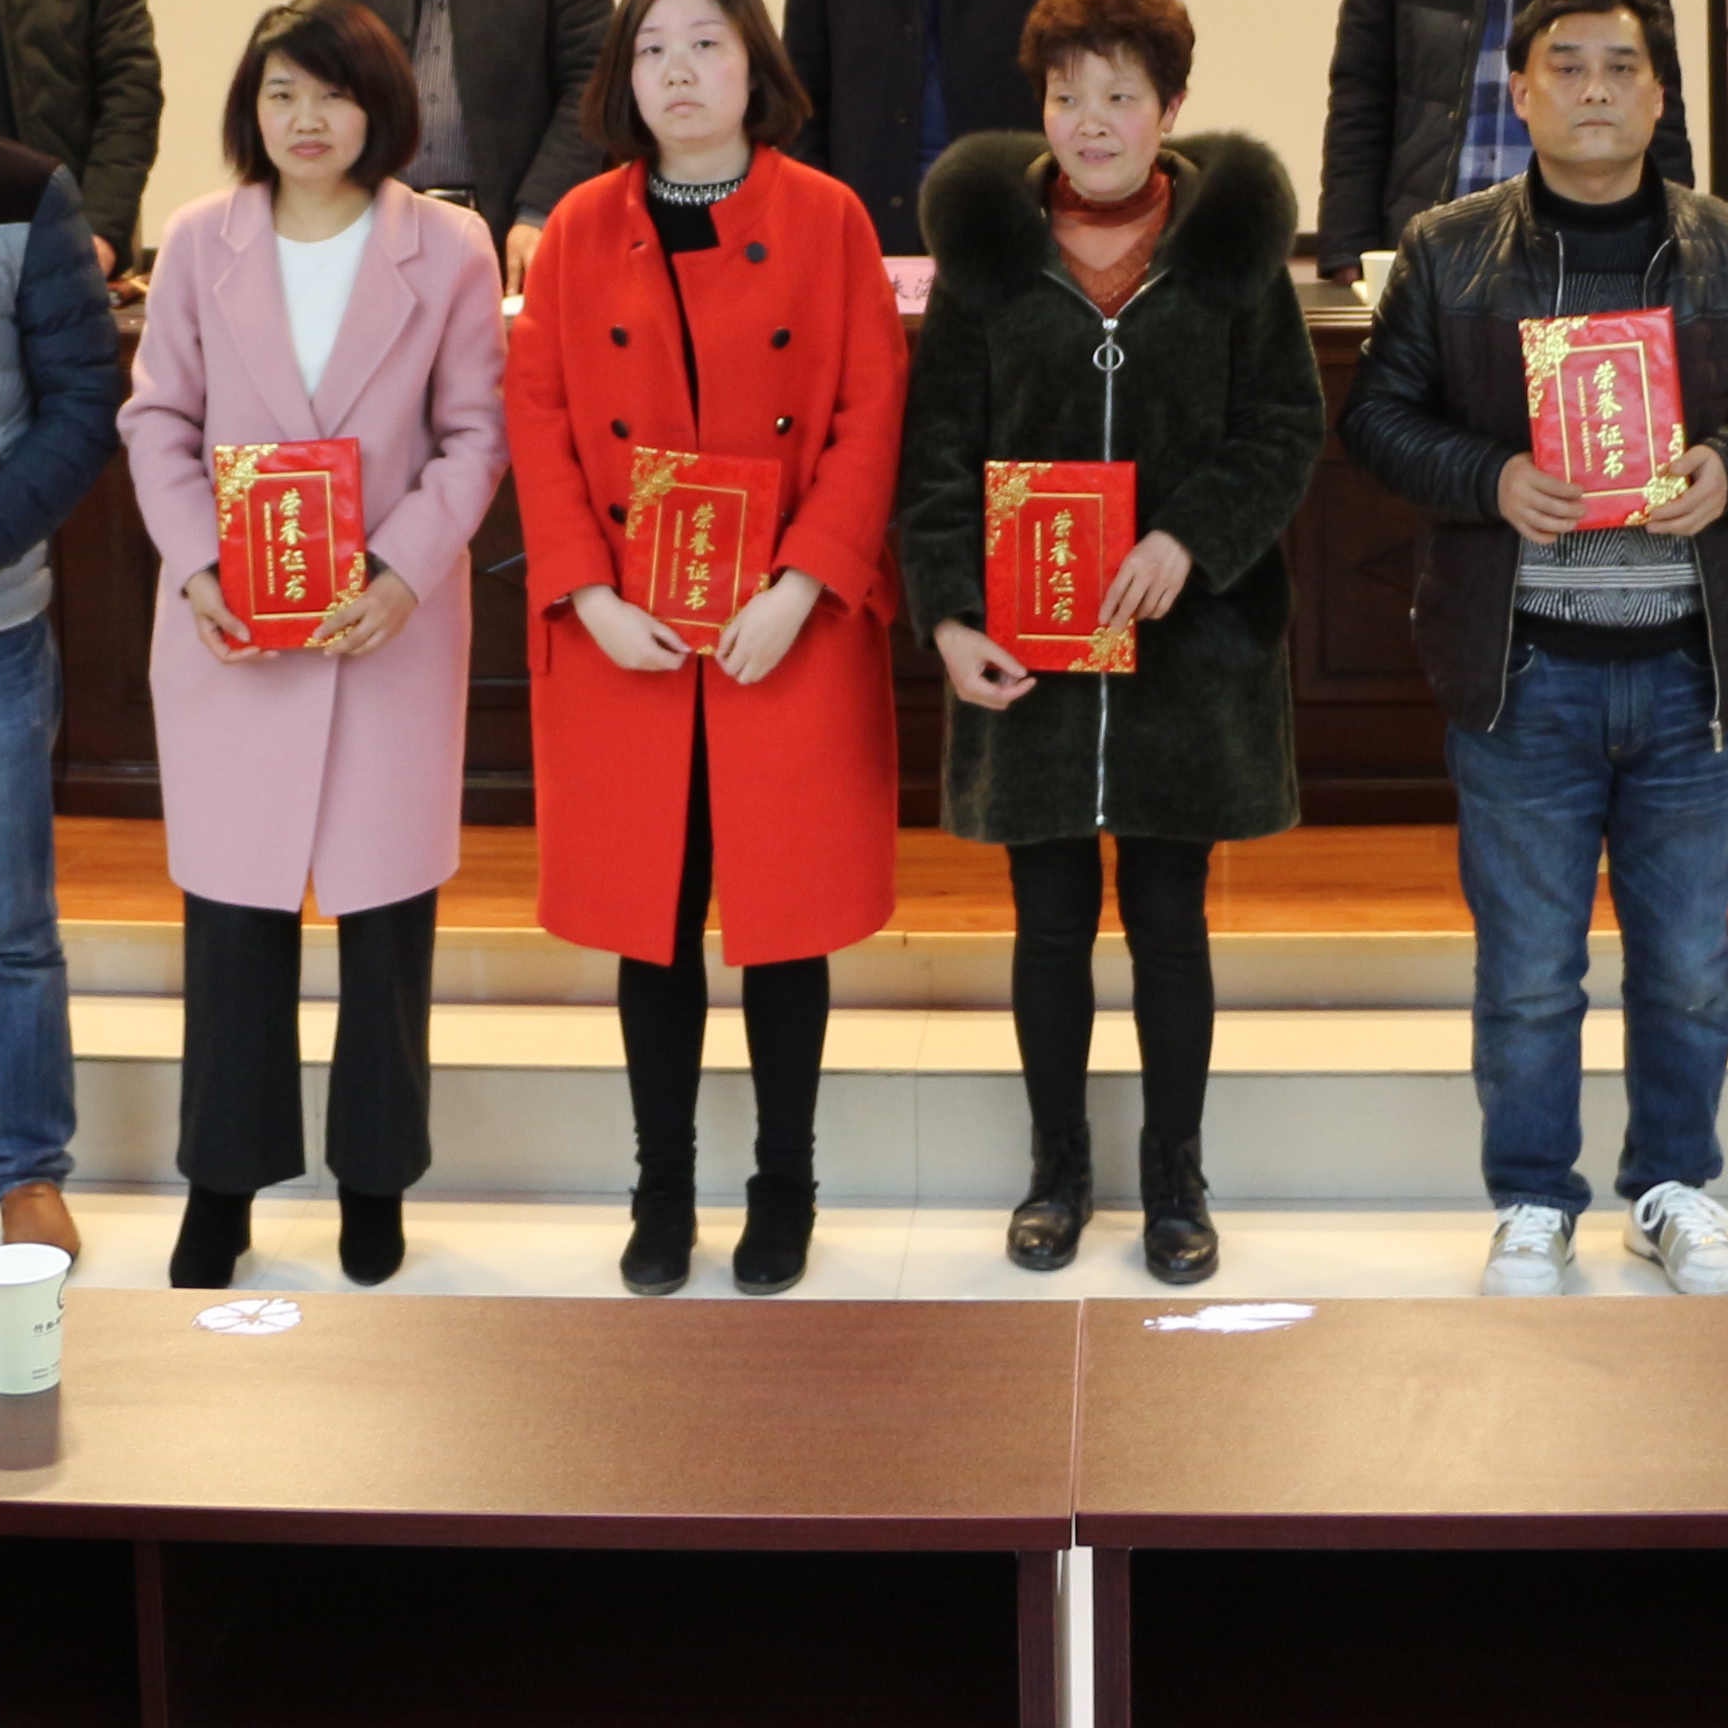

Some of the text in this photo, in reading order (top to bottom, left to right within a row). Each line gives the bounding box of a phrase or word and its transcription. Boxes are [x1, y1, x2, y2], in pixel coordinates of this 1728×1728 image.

[1592, 360, 1623, 478] 荣誉证书
[279, 488, 307, 602] 荣誉证书
[684, 500, 715, 609] 荣誉证书
[1049, 508, 1076, 624] 荣誉证书
